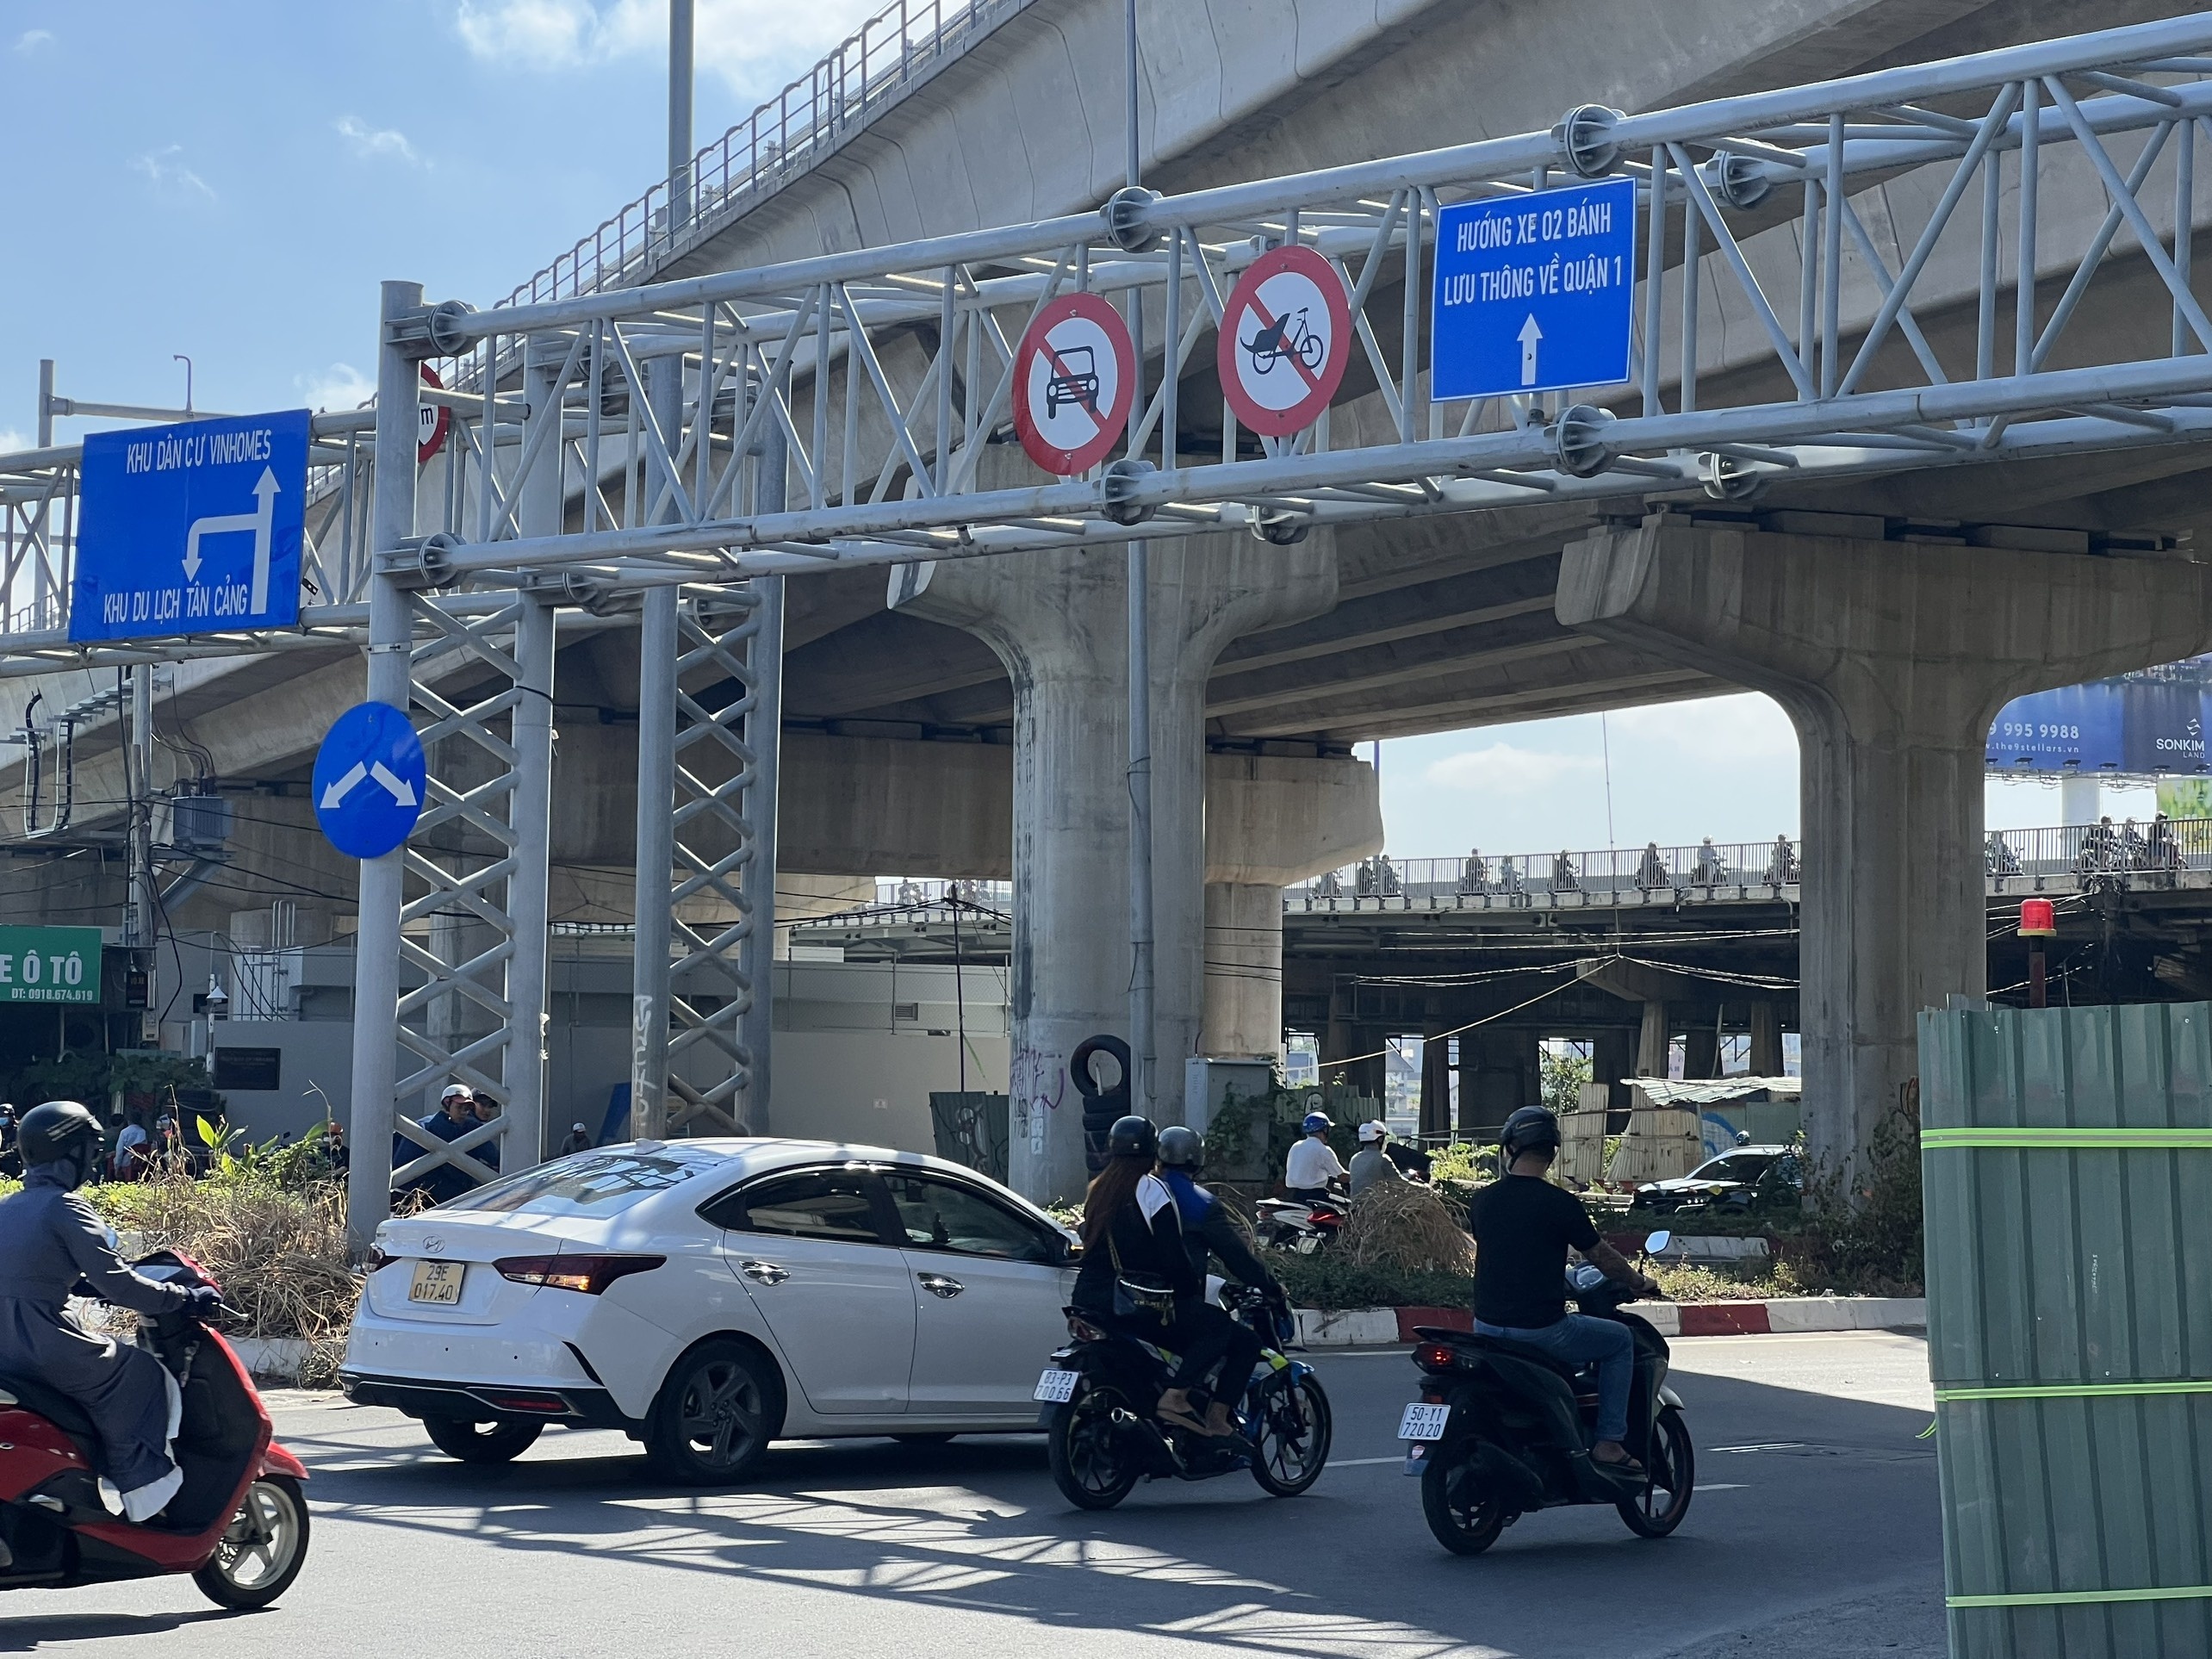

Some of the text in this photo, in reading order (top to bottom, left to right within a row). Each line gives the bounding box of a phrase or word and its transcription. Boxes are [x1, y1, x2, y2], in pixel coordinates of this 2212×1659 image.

[1457, 210, 1512, 252] HƯỚNG
[1516, 213, 1538, 245] XE
[1567, 197, 1612, 239] BÁNH
[1444, 252, 1622, 306] LƯU THÔNG VỀ QUẬN 1
[126, 429, 271, 474] KHU DÂN CƯ VINHOMES
[103, 574, 247, 624] KHU DU LỊCH TÂN CẢNG
[2004, 723, 2034, 737] 995
[2039, 724, 2079, 739] 9988
[2156, 738, 2205, 751] SONKIM
[22, 949, 40, 984] Ô
[49, 950, 83, 985] TÔ
[1402, 1422, 1441, 1438] 720.20
[1410, 1407, 1443, 1422] 50-Y1
